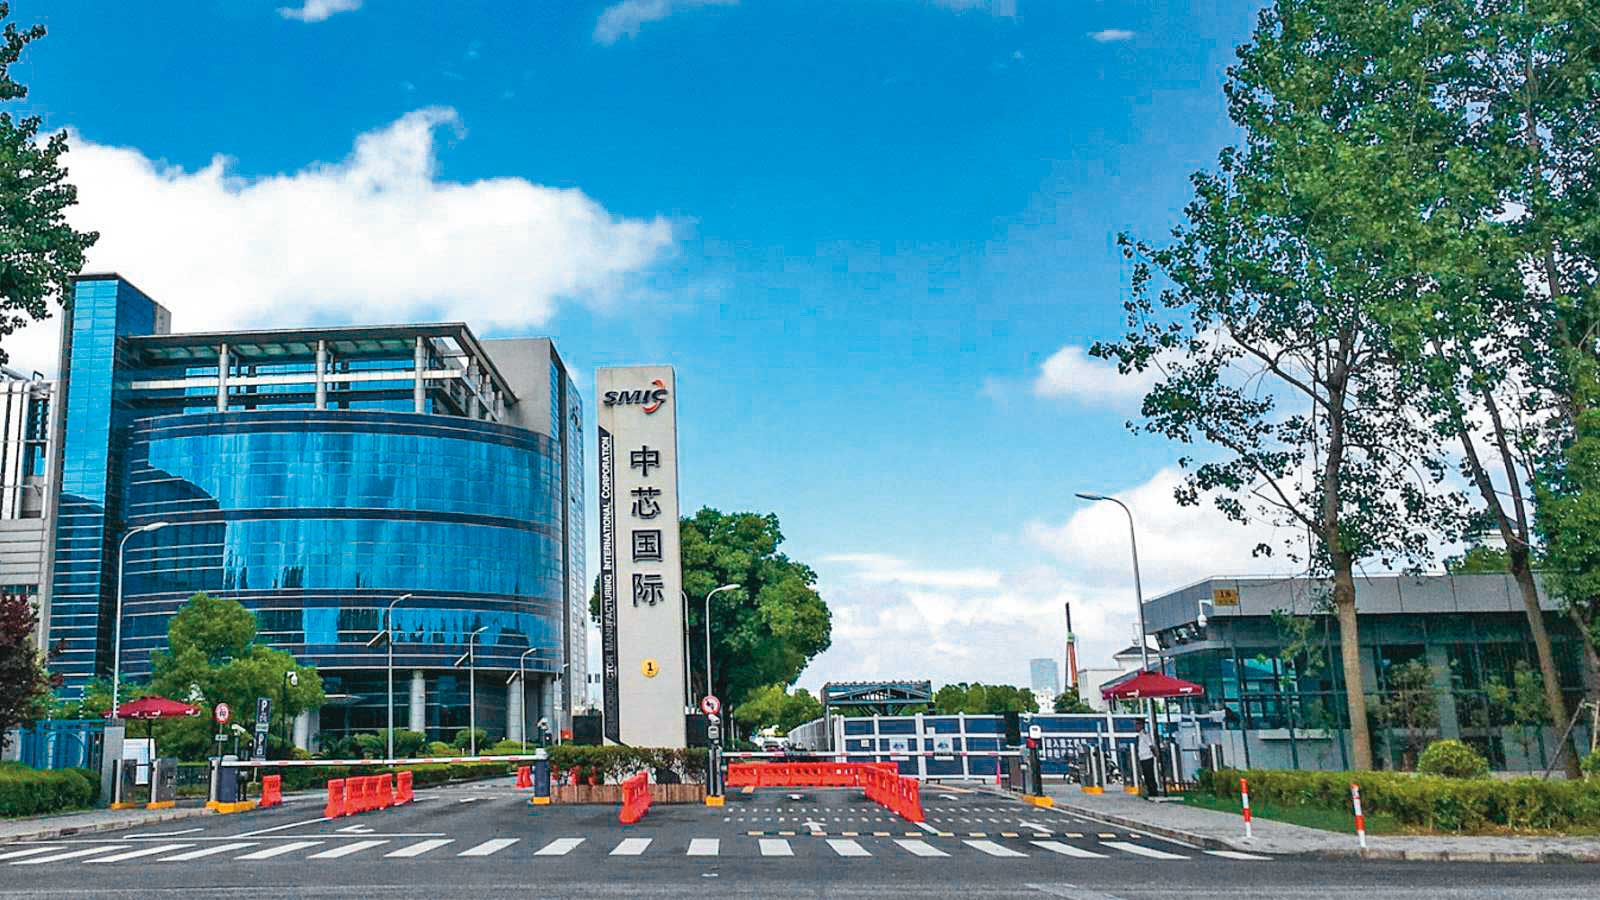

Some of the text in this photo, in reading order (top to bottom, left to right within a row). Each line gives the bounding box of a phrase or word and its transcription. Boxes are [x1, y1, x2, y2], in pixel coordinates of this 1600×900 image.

[604, 381, 669, 411] SMIC
[630, 445, 663, 606] 中芯国际
[601, 436, 617, 736] CONDUCTOR MANUFACTURING INTERNATIONAL CORPORATION
[261, 700, 268, 711] P
